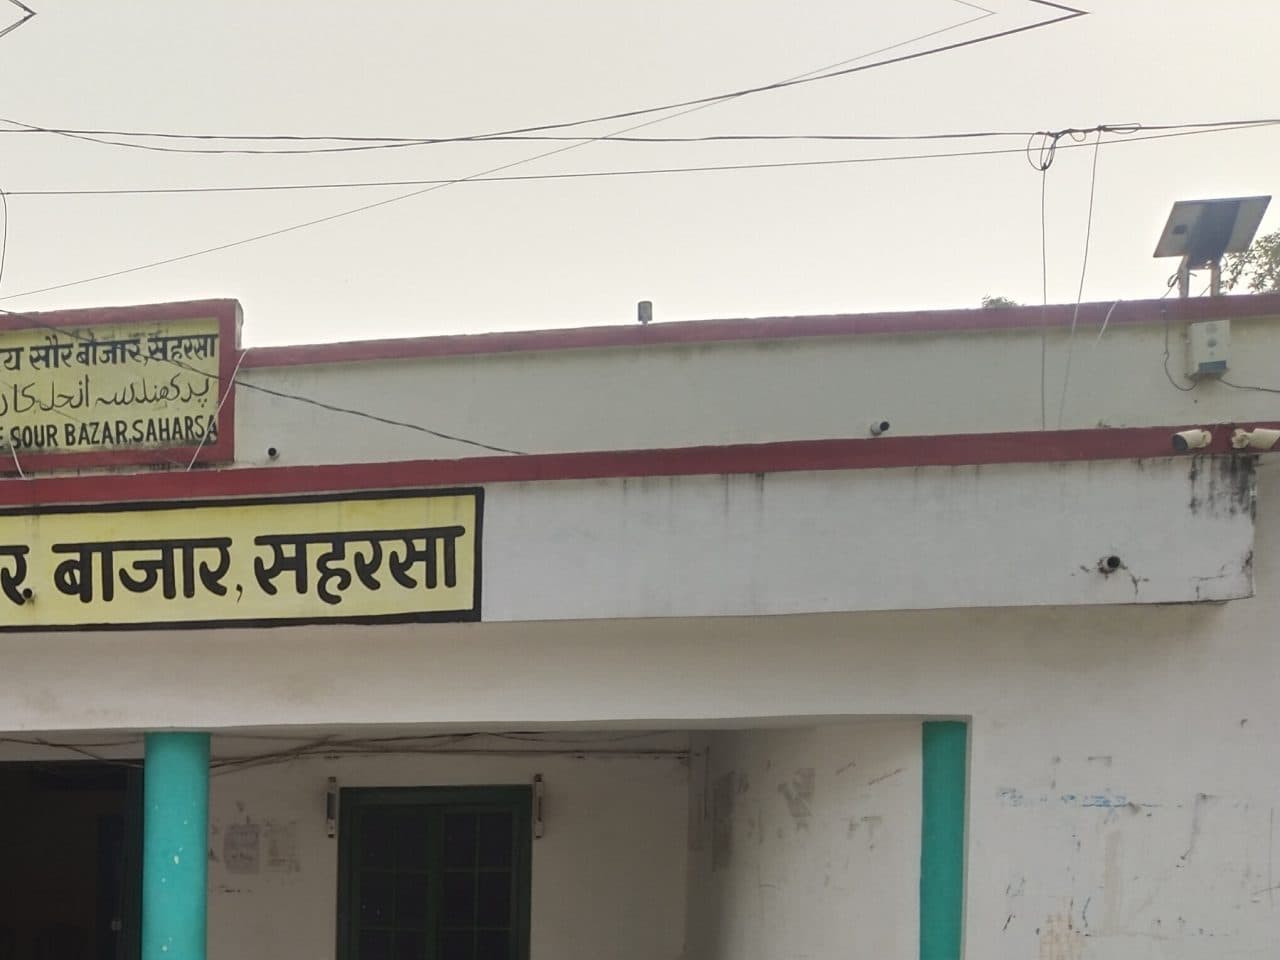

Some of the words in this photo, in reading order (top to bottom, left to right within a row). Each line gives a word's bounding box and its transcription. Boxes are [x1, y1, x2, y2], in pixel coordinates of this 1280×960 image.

[148, 334, 218, 361] सहरसा
[10, 423, 59, 448] SOUR
[253, 525, 466, 605] सहरसा
